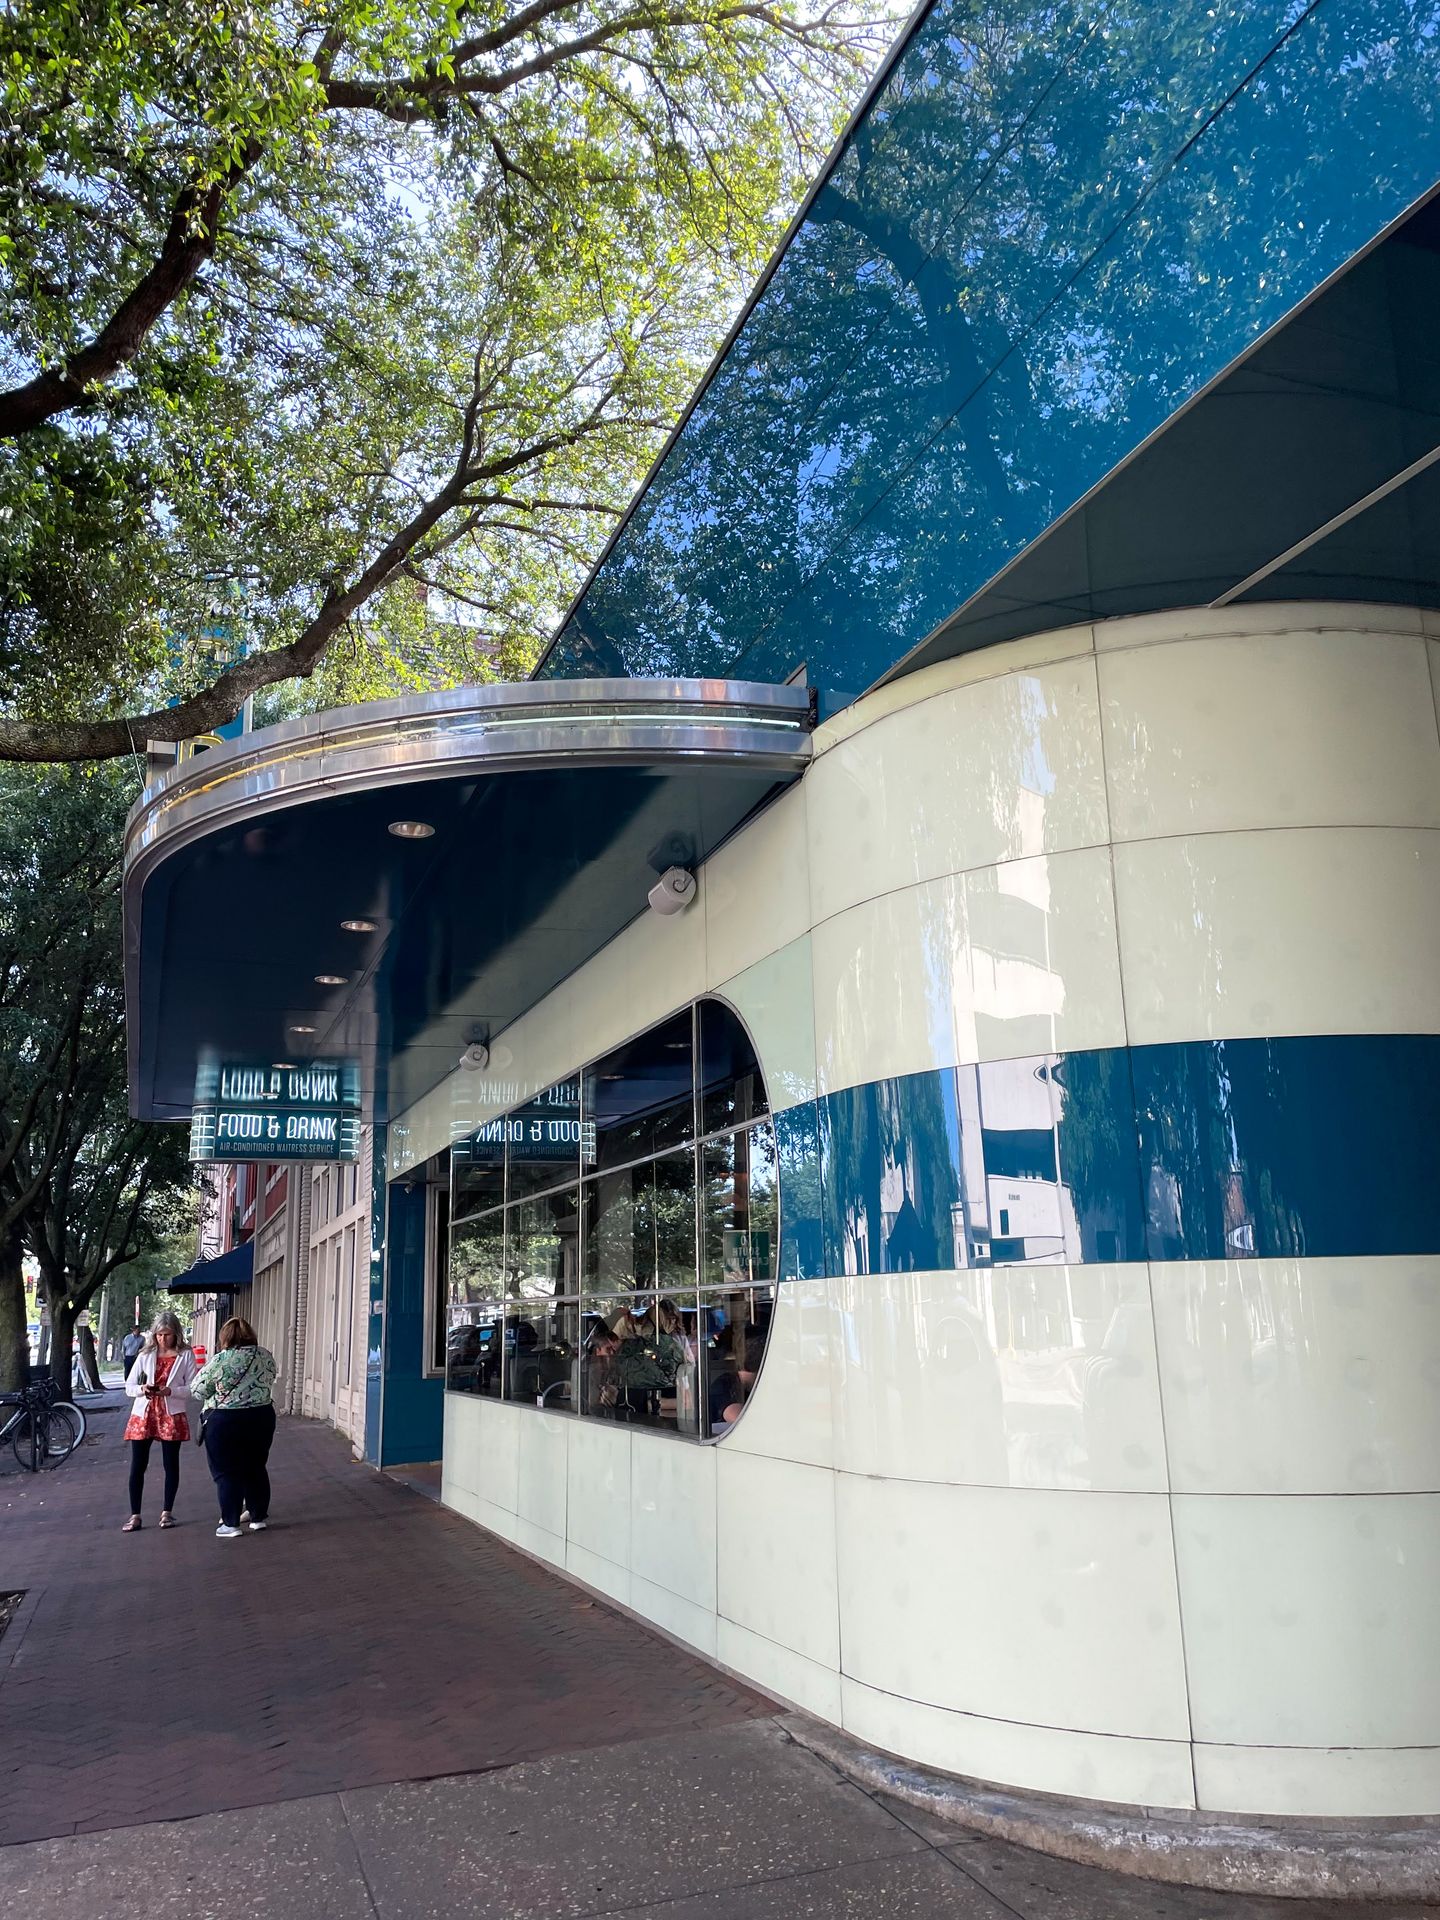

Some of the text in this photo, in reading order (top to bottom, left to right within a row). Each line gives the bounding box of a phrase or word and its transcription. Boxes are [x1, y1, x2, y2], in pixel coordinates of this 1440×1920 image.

[217, 1113, 337, 1141] FOOD & DRINK
[219, 1141, 334, 1154] AIR-CONDITIONED WAITRESS SERVICE
